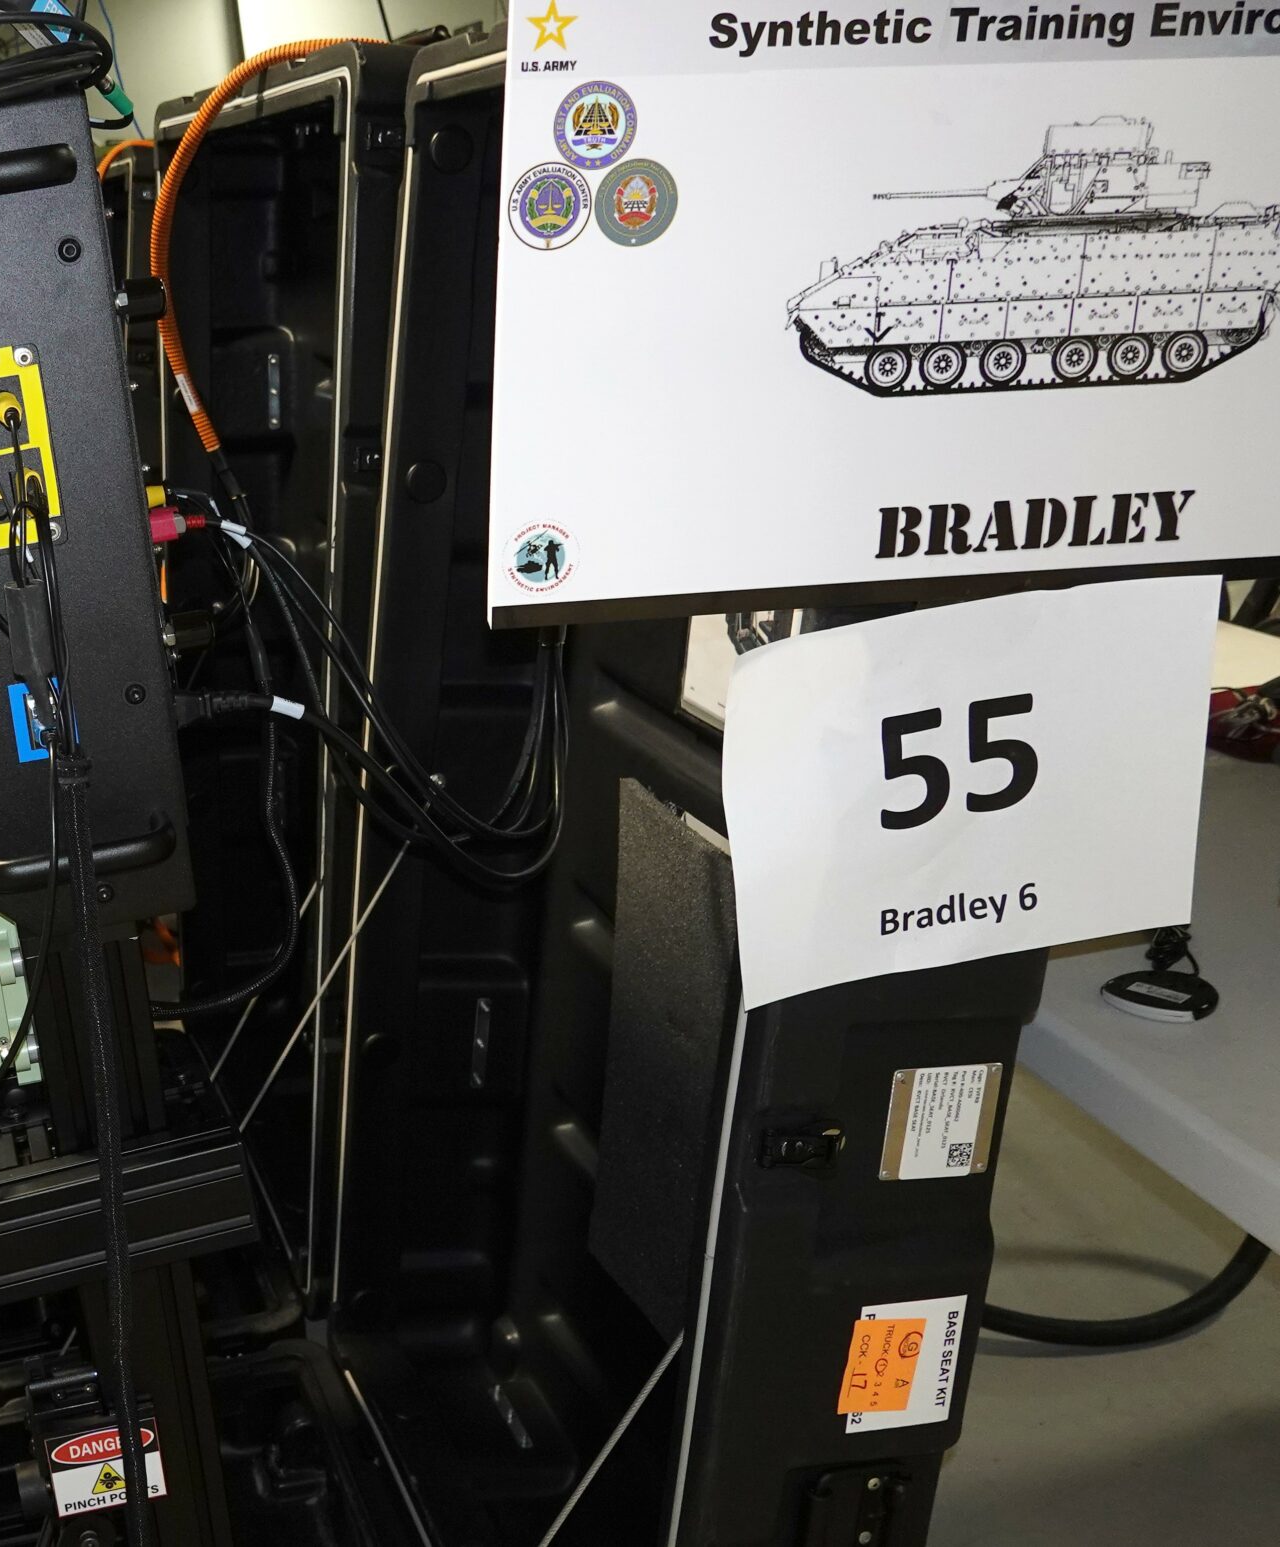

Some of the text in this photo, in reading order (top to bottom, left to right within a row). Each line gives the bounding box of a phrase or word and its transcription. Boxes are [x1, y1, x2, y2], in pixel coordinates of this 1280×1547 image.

[709, 10, 932, 58] Synthetic
[949, 3, 1135, 48] Training
[521, 60, 577, 72] U.S. ARMY
[557, 112, 567, 134] TEST
[564, 92, 580, 110] AND
[581, 85, 632, 110] EVALUATION
[610, 113, 634, 159] COMMAND
[516, 175, 532, 195] ARMY
[532, 167, 577, 180] EVALUATION
[575, 180, 589, 209] CENTER
[514, 523, 570, 541] PROJECT MANAGER
[875, 489, 1196, 559] BRADLEY
[508, 563, 574, 592] SYNTHETIC ENVIRONMENT
[880, 692, 1039, 830] 55
[880, 882, 1039, 936] Bradley 6
[935, 1311, 959, 1407] BASE SEAT KIT
[65, 1496, 106, 1512] PINCH
